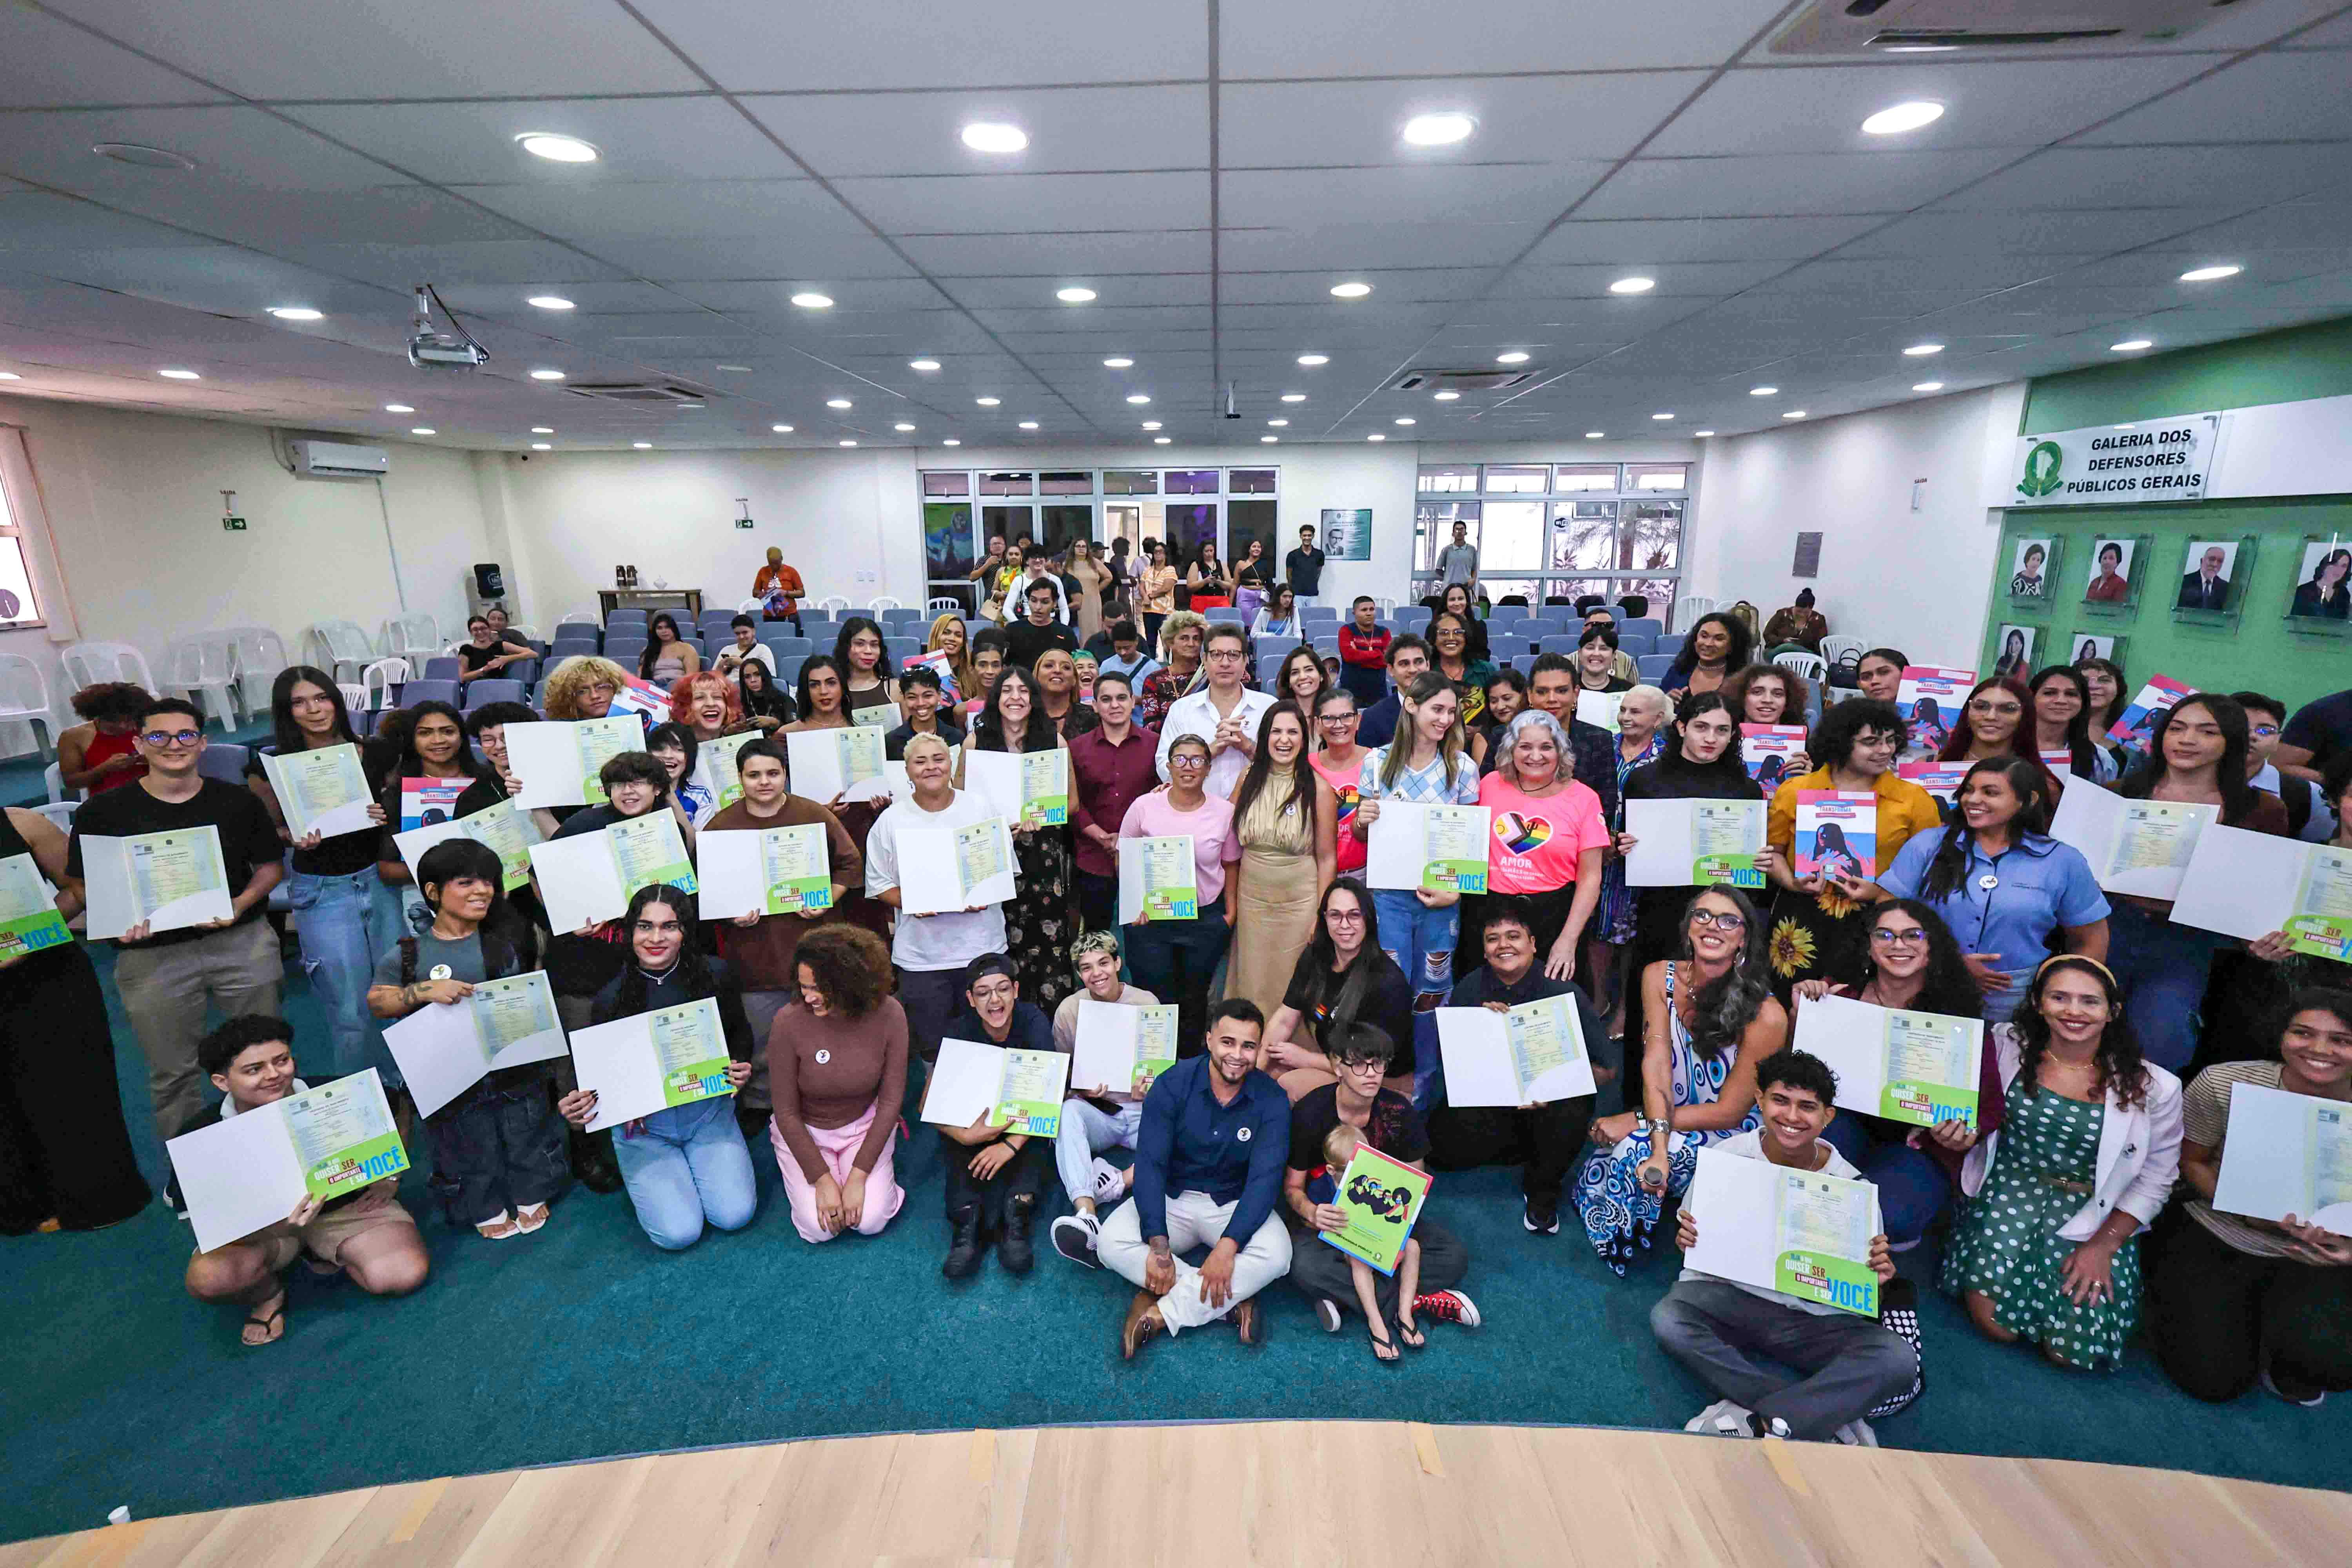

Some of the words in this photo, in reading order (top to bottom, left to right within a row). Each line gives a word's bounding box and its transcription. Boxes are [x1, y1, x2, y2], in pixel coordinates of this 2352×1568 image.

[2091, 433, 2153, 450] GALERIA
[2158, 429, 2192, 443] DOS
[2088, 452, 2186, 470] DEFENSORES
[2067, 479, 2136, 493] PÚBLICOS
[2141, 474, 2201, 489] GERAIS
[1045, 805, 1066, 822] VOCÊ
[1501, 856, 1532, 869] AMOR
[1456, 873, 1485, 891] VOCÊ
[800, 887, 830, 907] VOCÊ
[1171, 898, 1195, 916] VOCÊ
[16, 922, 69, 950] VOCÊ
[688, 1073, 698, 1082] SER
[1916, 1093, 1929, 1103] SER
[1028, 1116, 1056, 1134] VOCÊ
[314, 1163, 340, 1181] QUISER
[341, 1158, 356, 1170] SER
[357, 1145, 404, 1180] VOCÊ
[334, 1167, 361, 1181] IMPORTANTE
[1785, 1259, 1810, 1274] QUISER
[1812, 1266, 1826, 1278] SER
[1801, 1275, 1829, 1289] IMPORTANTE
[1820, 1289, 1832, 1300] SER
[1826, 1276, 1873, 1312] VOCÊ
